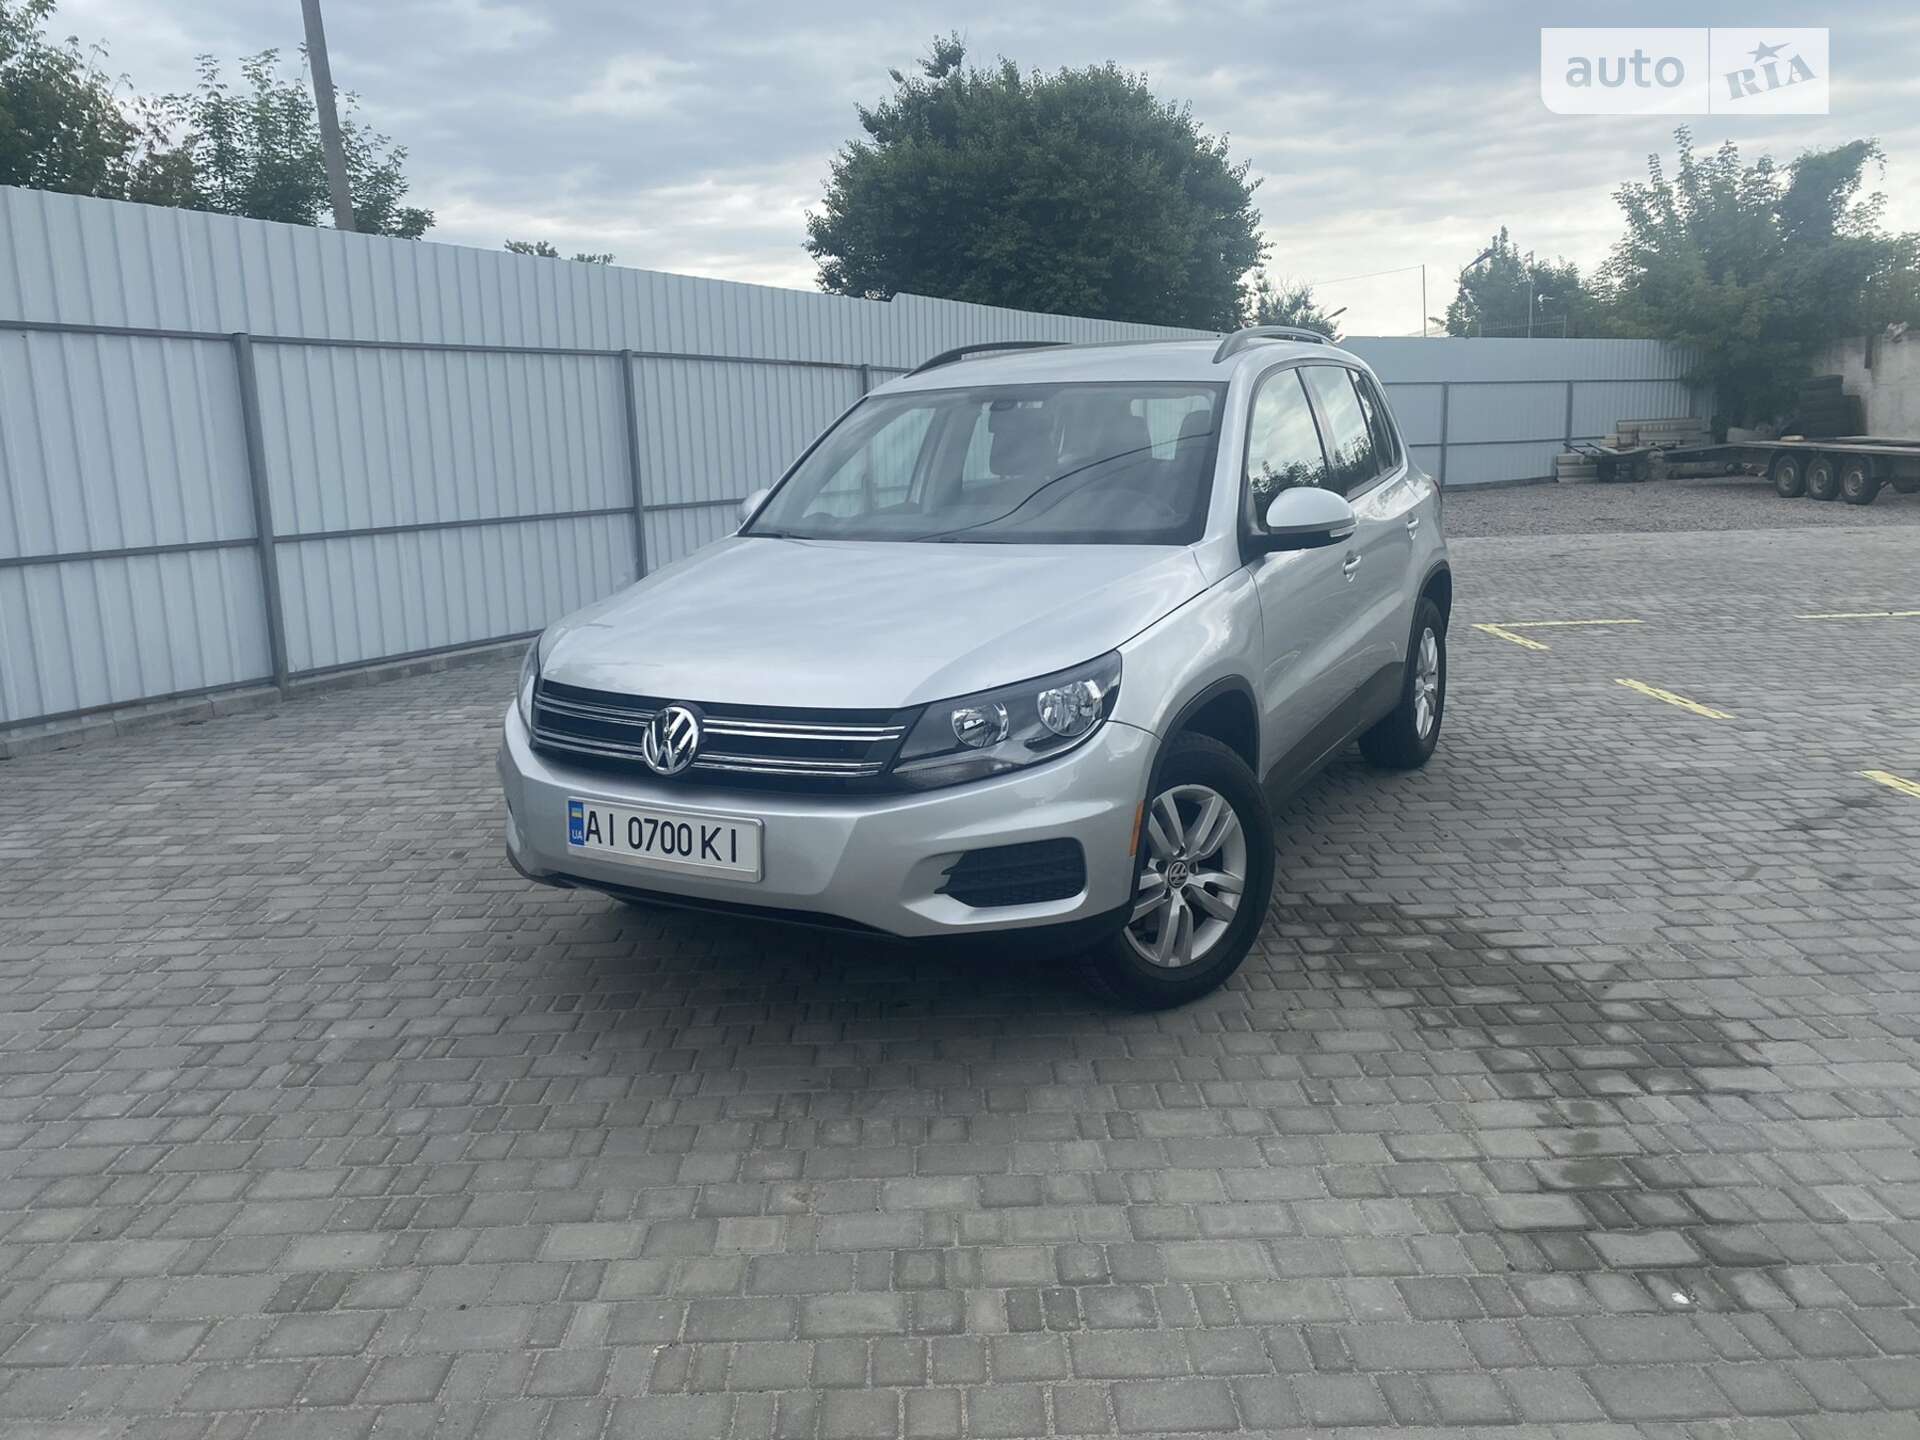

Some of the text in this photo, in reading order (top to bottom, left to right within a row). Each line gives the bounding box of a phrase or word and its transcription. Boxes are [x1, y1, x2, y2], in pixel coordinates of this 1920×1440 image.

[571, 829, 583, 841] UA
[585, 810, 615, 847] AI
[627, 816, 693, 857] 0700
